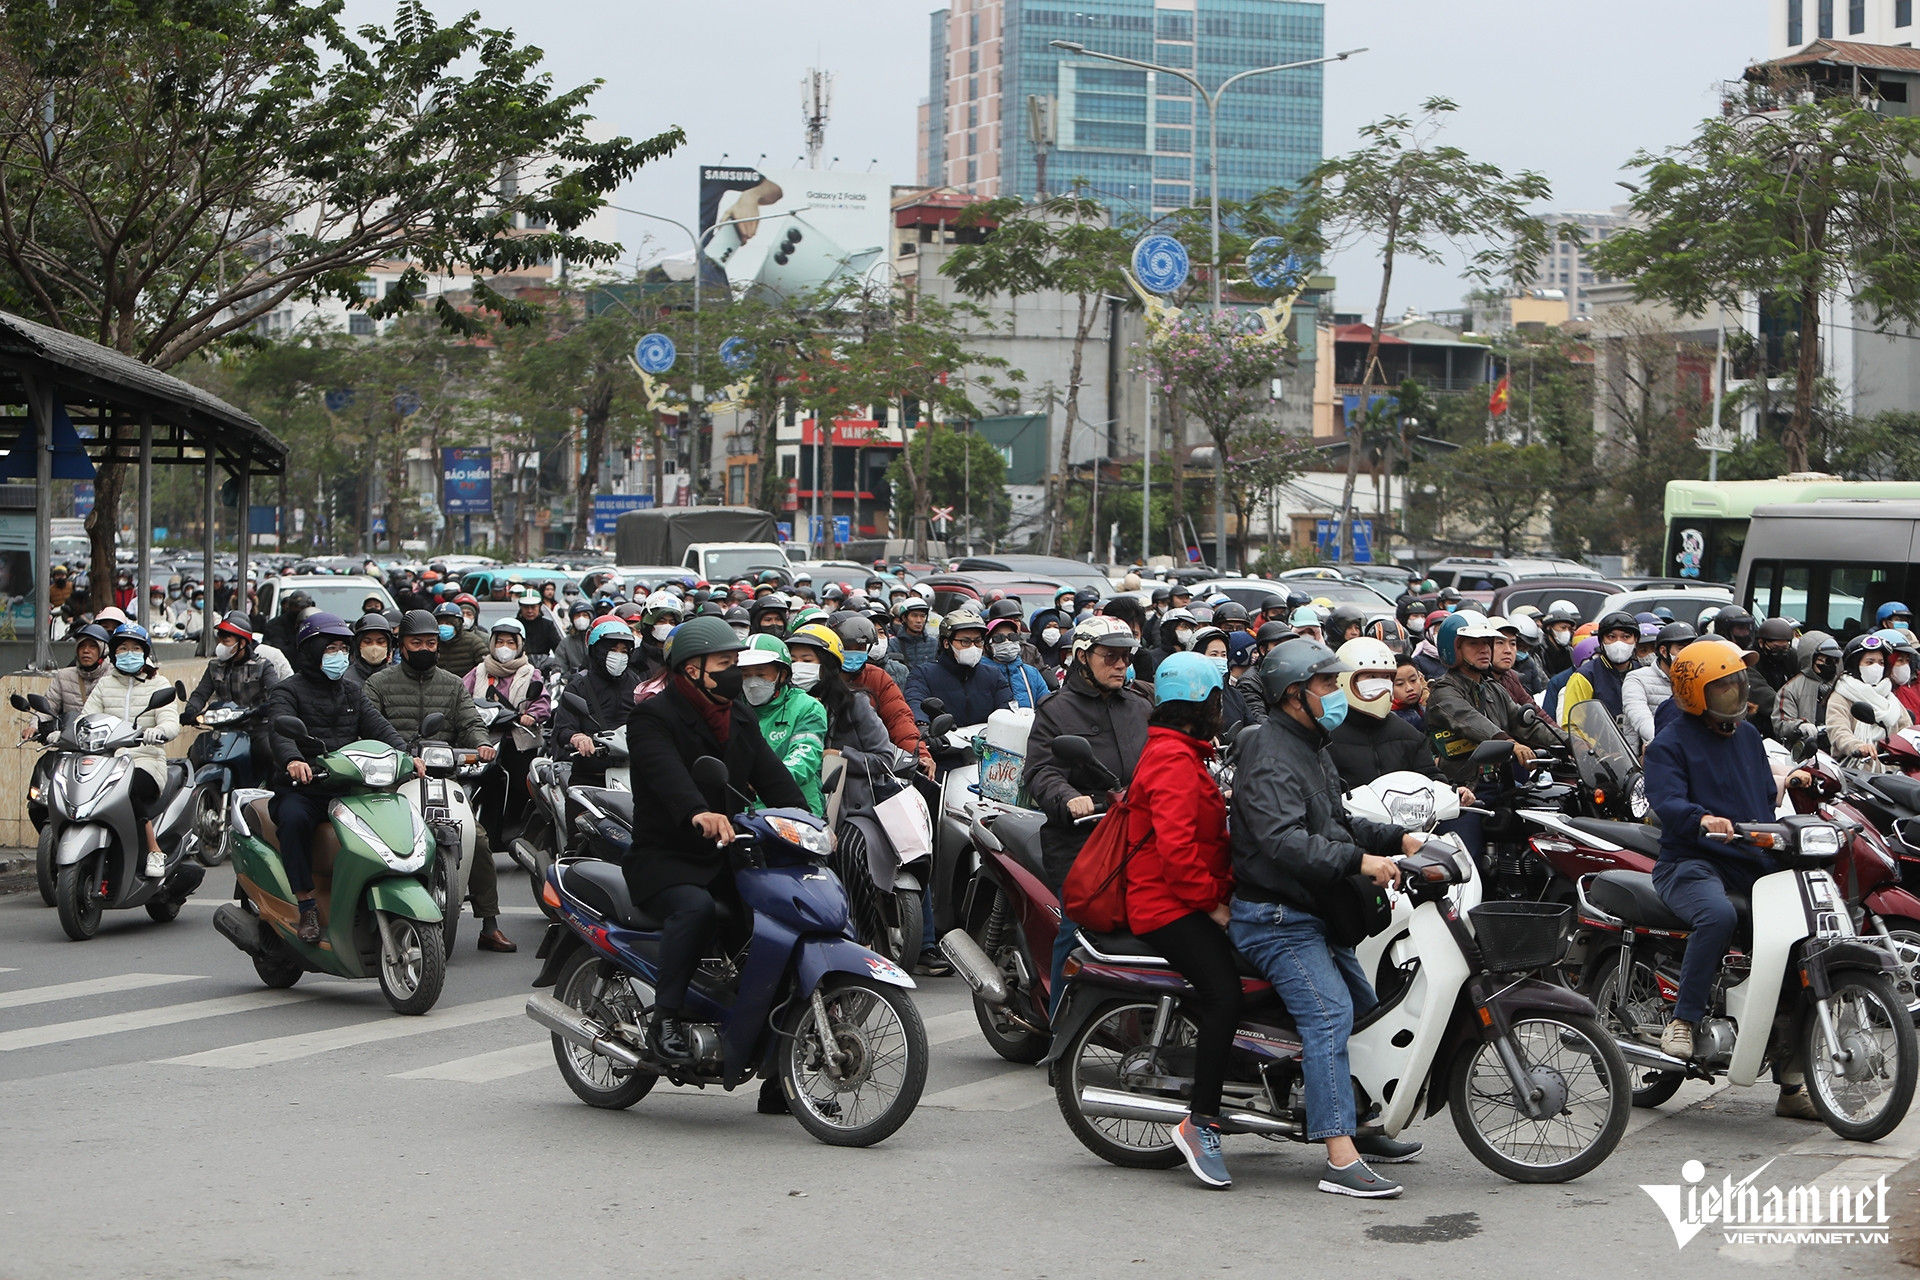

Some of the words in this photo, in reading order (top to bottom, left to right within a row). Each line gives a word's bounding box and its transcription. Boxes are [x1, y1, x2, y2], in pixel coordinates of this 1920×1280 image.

[704, 170, 760, 181] SAMSUNG
[806, 191, 836, 200] Galaxy
[1648, 928, 1670, 936] HONDA
